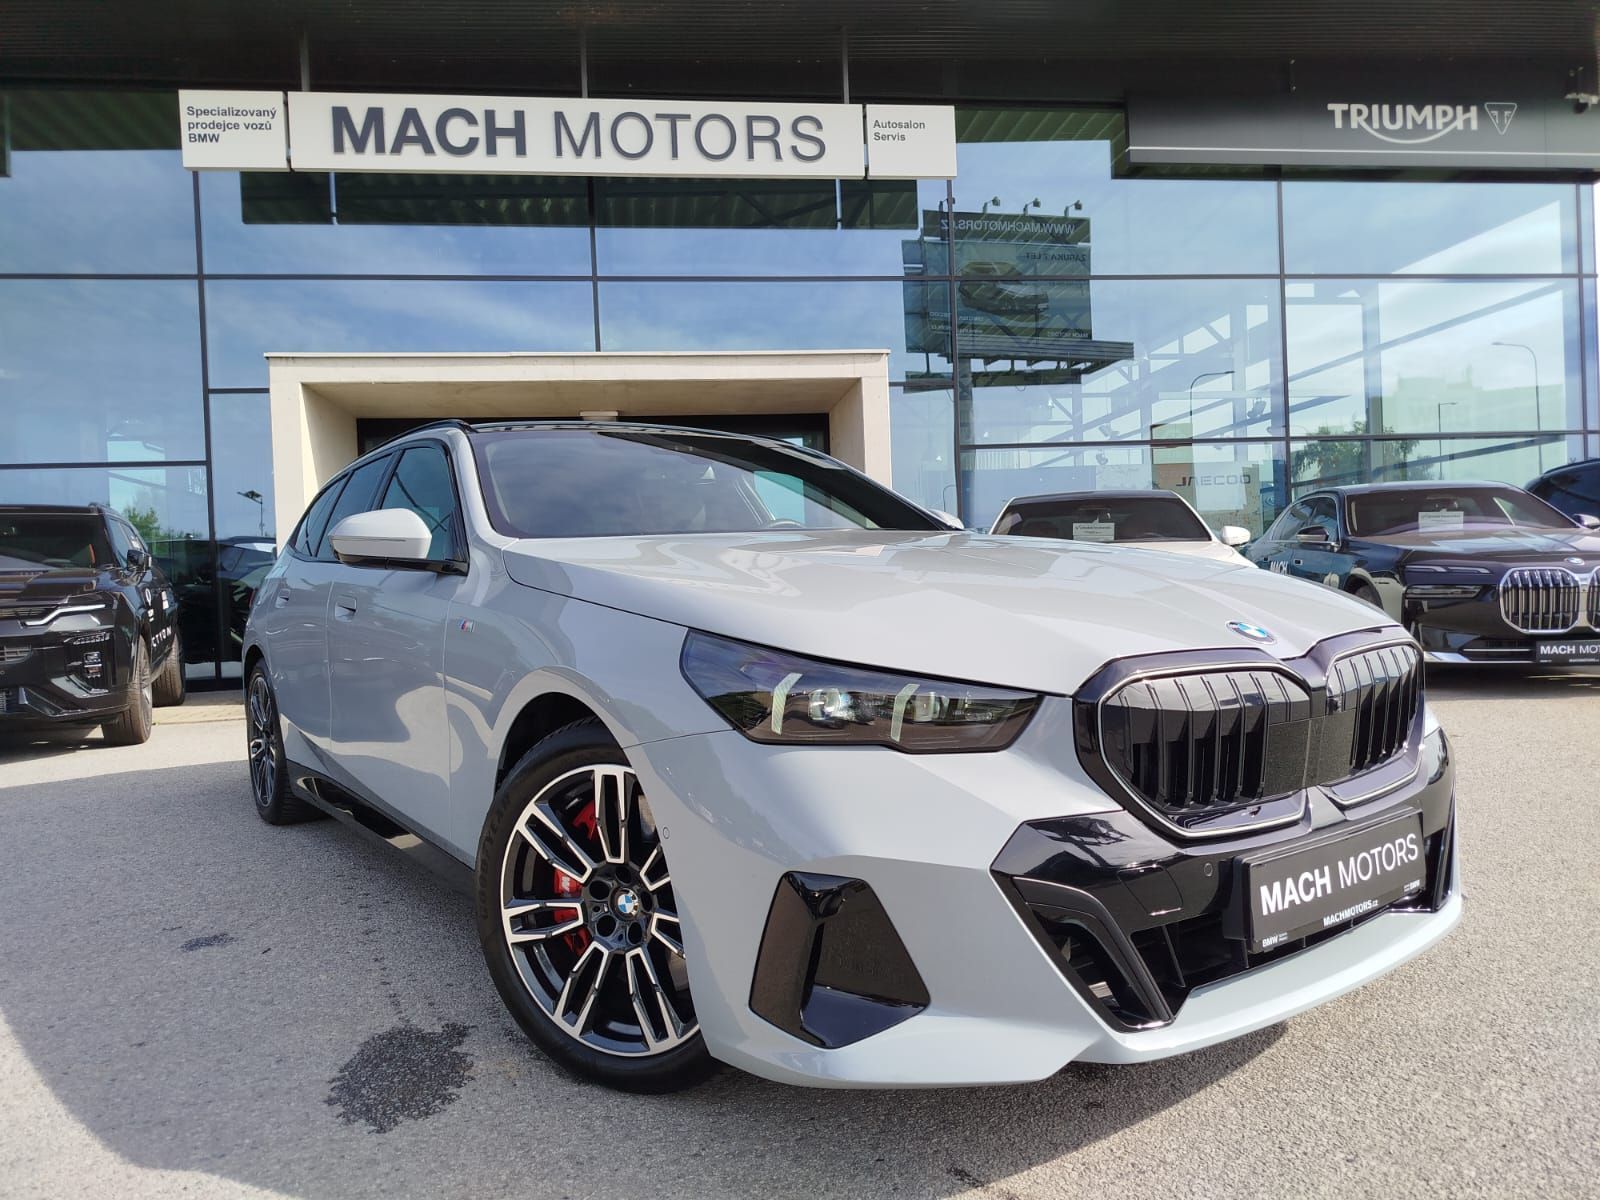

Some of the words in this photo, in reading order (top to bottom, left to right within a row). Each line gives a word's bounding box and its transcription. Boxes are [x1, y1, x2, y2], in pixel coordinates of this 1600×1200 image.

[187, 105, 277, 119] Specializovaný
[188, 120, 240, 133] prodejce
[243, 120, 272, 131] vozů
[873, 119, 926, 130] Autosalon
[1327, 103, 1478, 143] TRIUMPH
[188, 133, 220, 143] BMW
[331, 106, 527, 157] MACH
[553, 110, 826, 162] MOTORS
[873, 132, 906, 142] Servis
[1540, 645, 1576, 655] MACH
[1260, 865, 1332, 915] MACH
[1338, 833, 1418, 889] MOTORS
[1262, 935, 1278, 948] BMW
